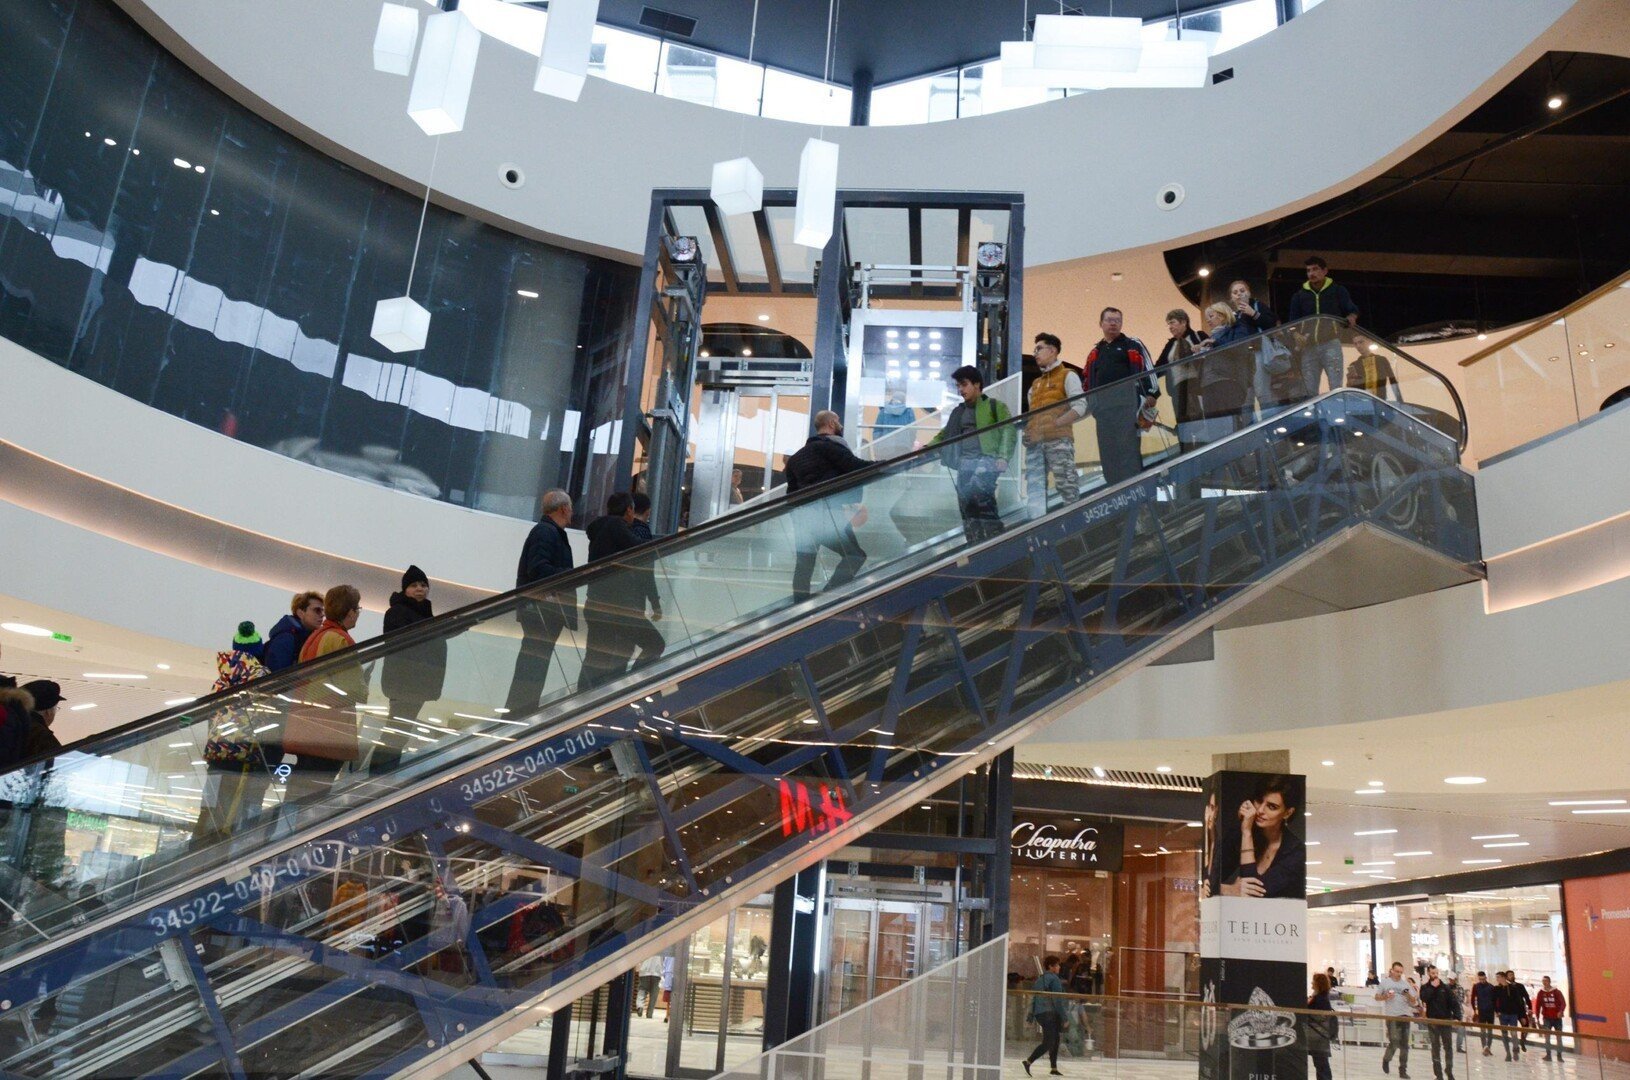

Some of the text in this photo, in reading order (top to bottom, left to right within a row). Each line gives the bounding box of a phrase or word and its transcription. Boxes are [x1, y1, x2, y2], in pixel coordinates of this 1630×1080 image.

[460, 729, 596, 801] 34522-040-010
[1010, 848, 1098, 862] IJUTERIA
[1011, 822, 1098, 859] Cleopatra
[151, 847, 325, 936] 34522-040-010
[1228, 920, 1299, 937] TEILOR
